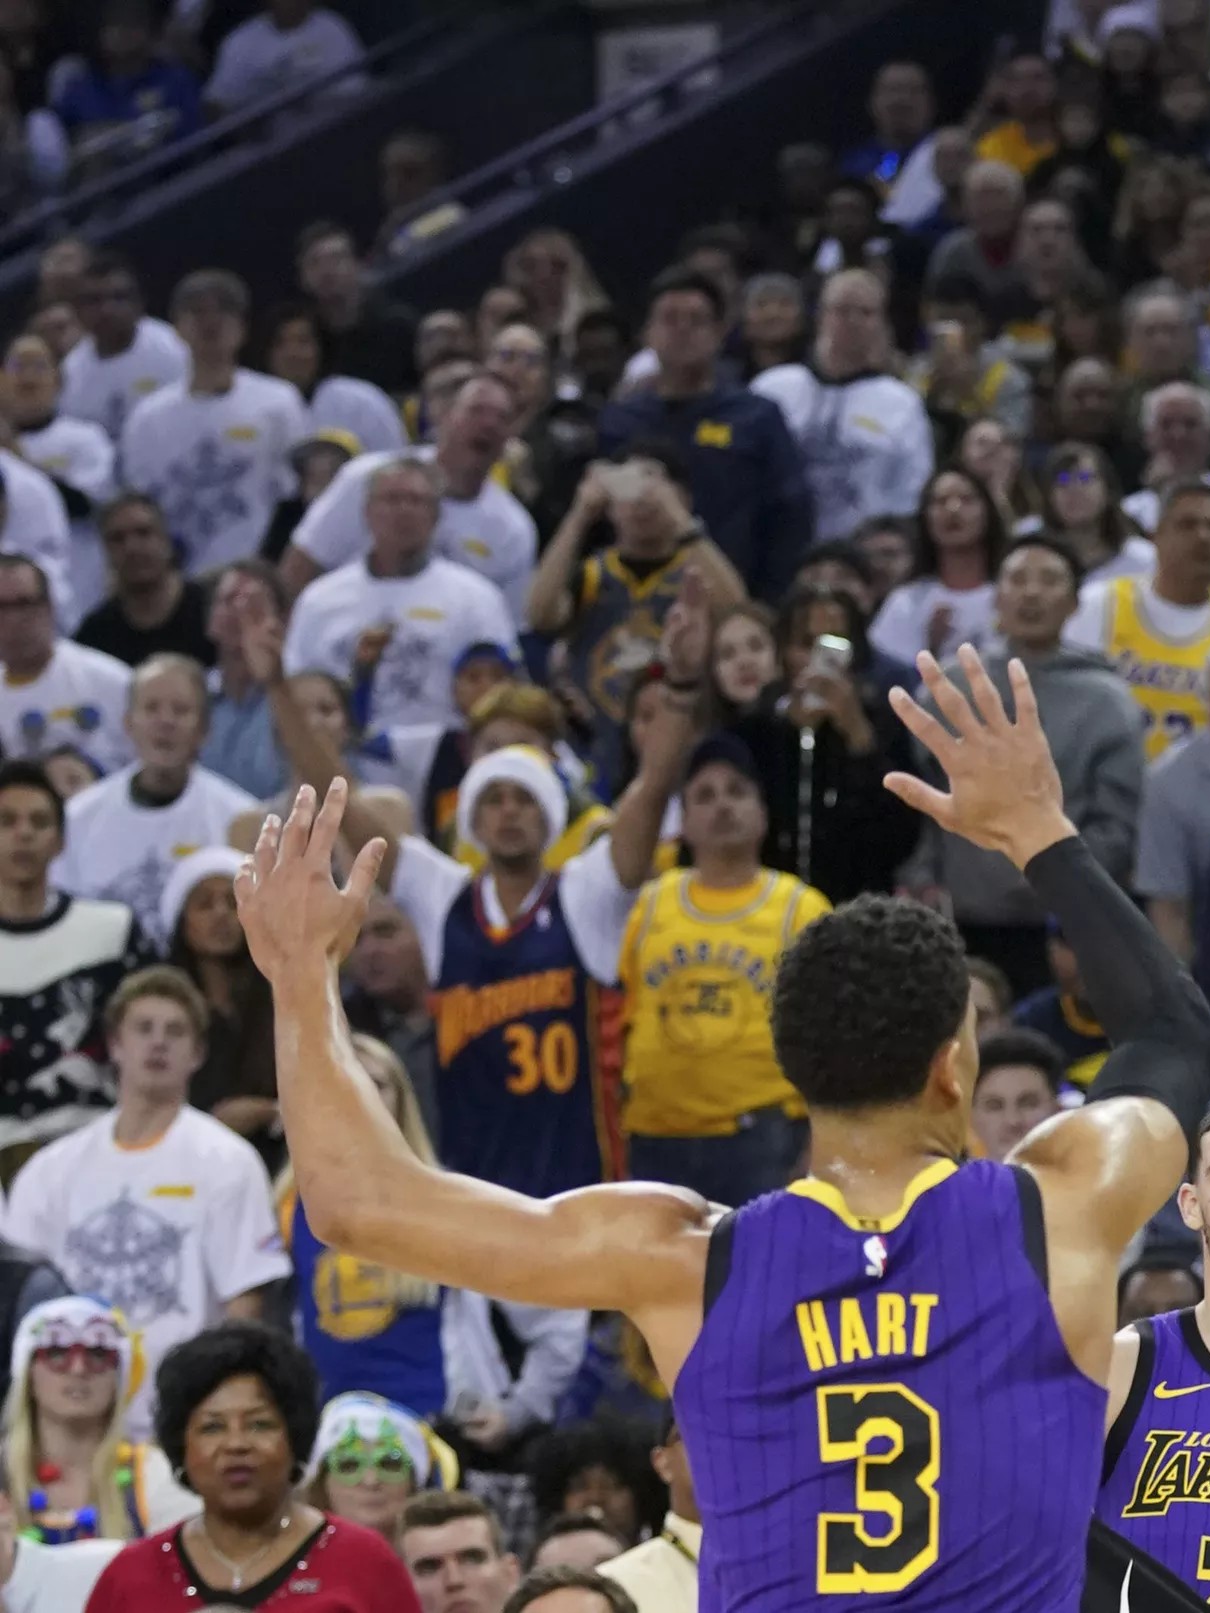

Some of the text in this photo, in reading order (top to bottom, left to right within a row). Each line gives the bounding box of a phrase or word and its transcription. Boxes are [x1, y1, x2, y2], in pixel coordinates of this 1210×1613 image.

[503, 1020, 579, 1095] 30
[795, 1292, 940, 1372] HART
[816, 1382, 940, 1594] 3
